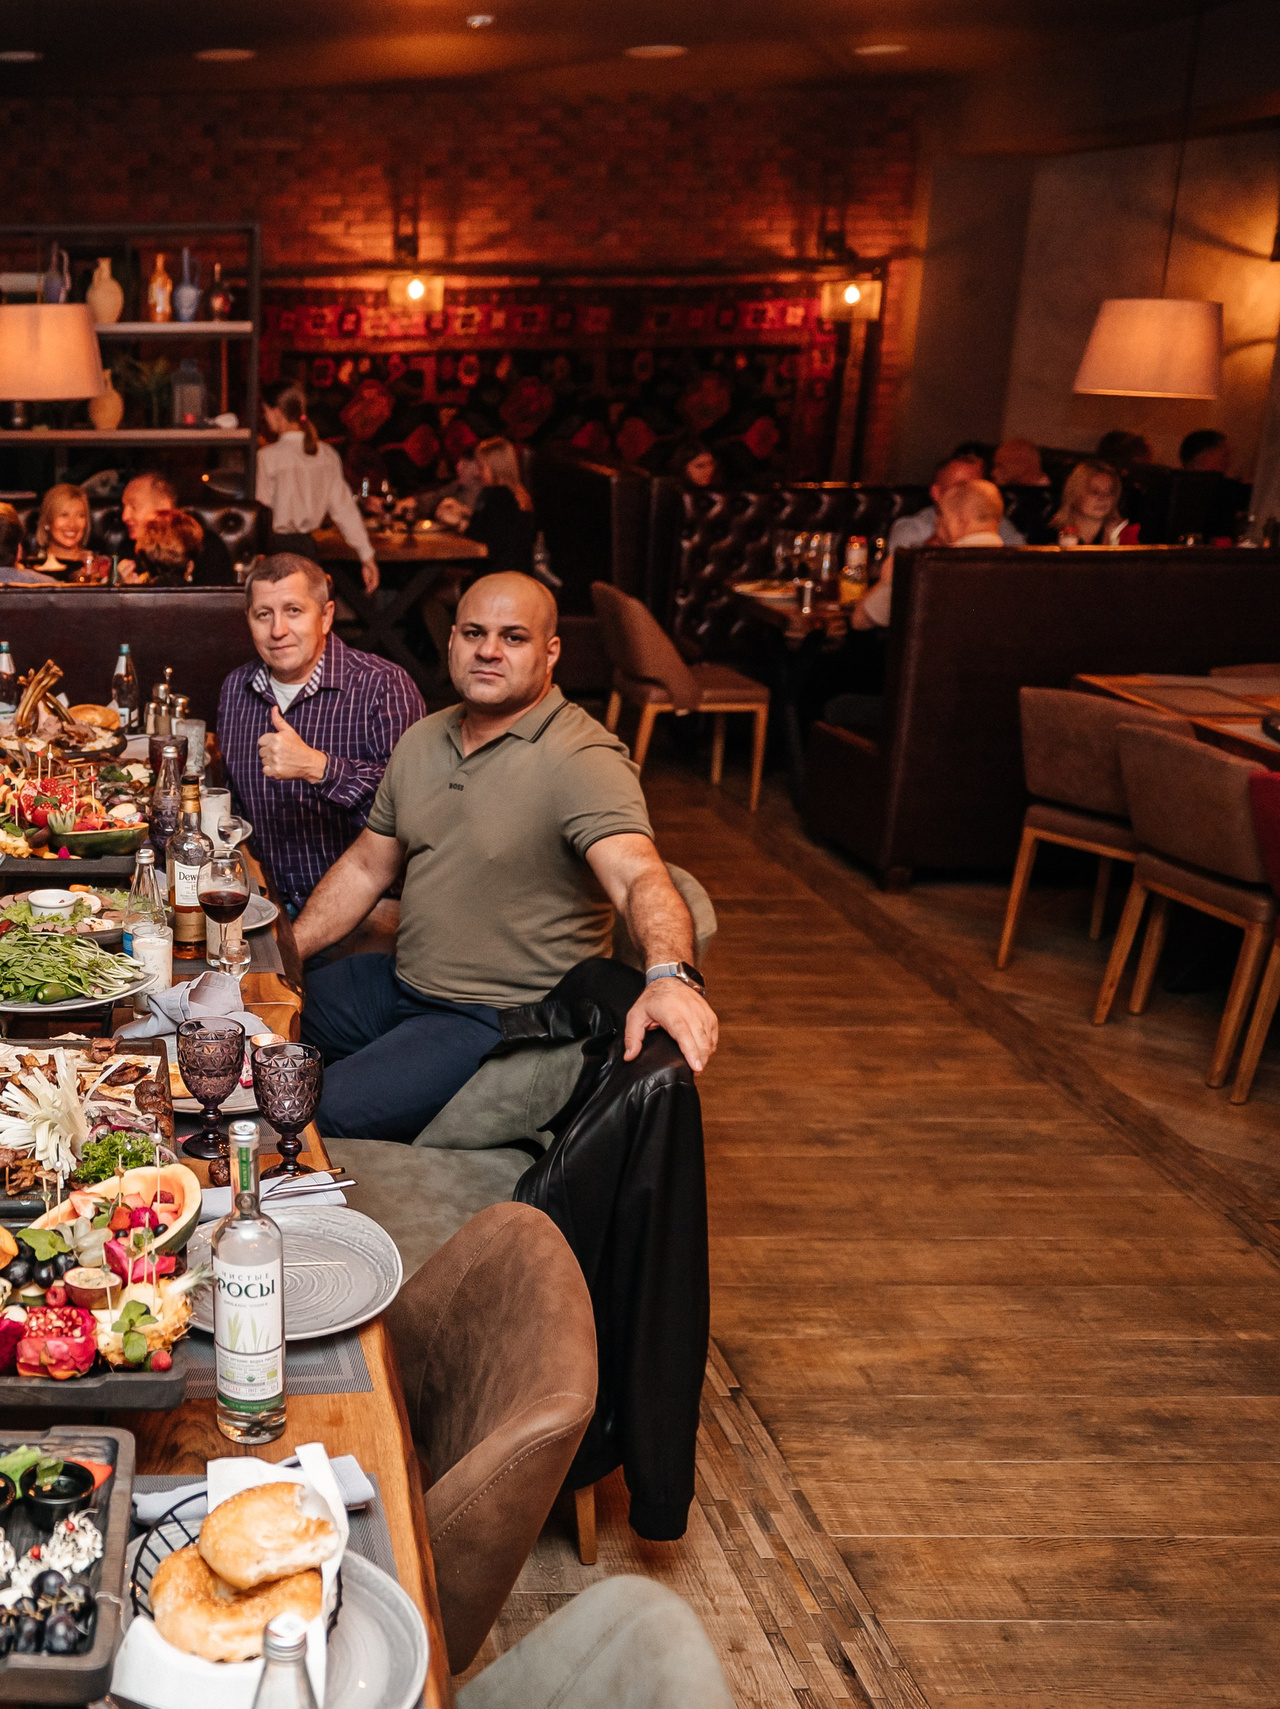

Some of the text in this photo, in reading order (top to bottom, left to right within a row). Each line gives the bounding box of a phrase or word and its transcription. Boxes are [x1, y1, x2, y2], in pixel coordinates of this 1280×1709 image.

[449, 783, 464, 791] BOSS
[222, 1271, 269, 1281] ЧИСТЫЕ
[217, 1277, 275, 1298] РОСЫ
